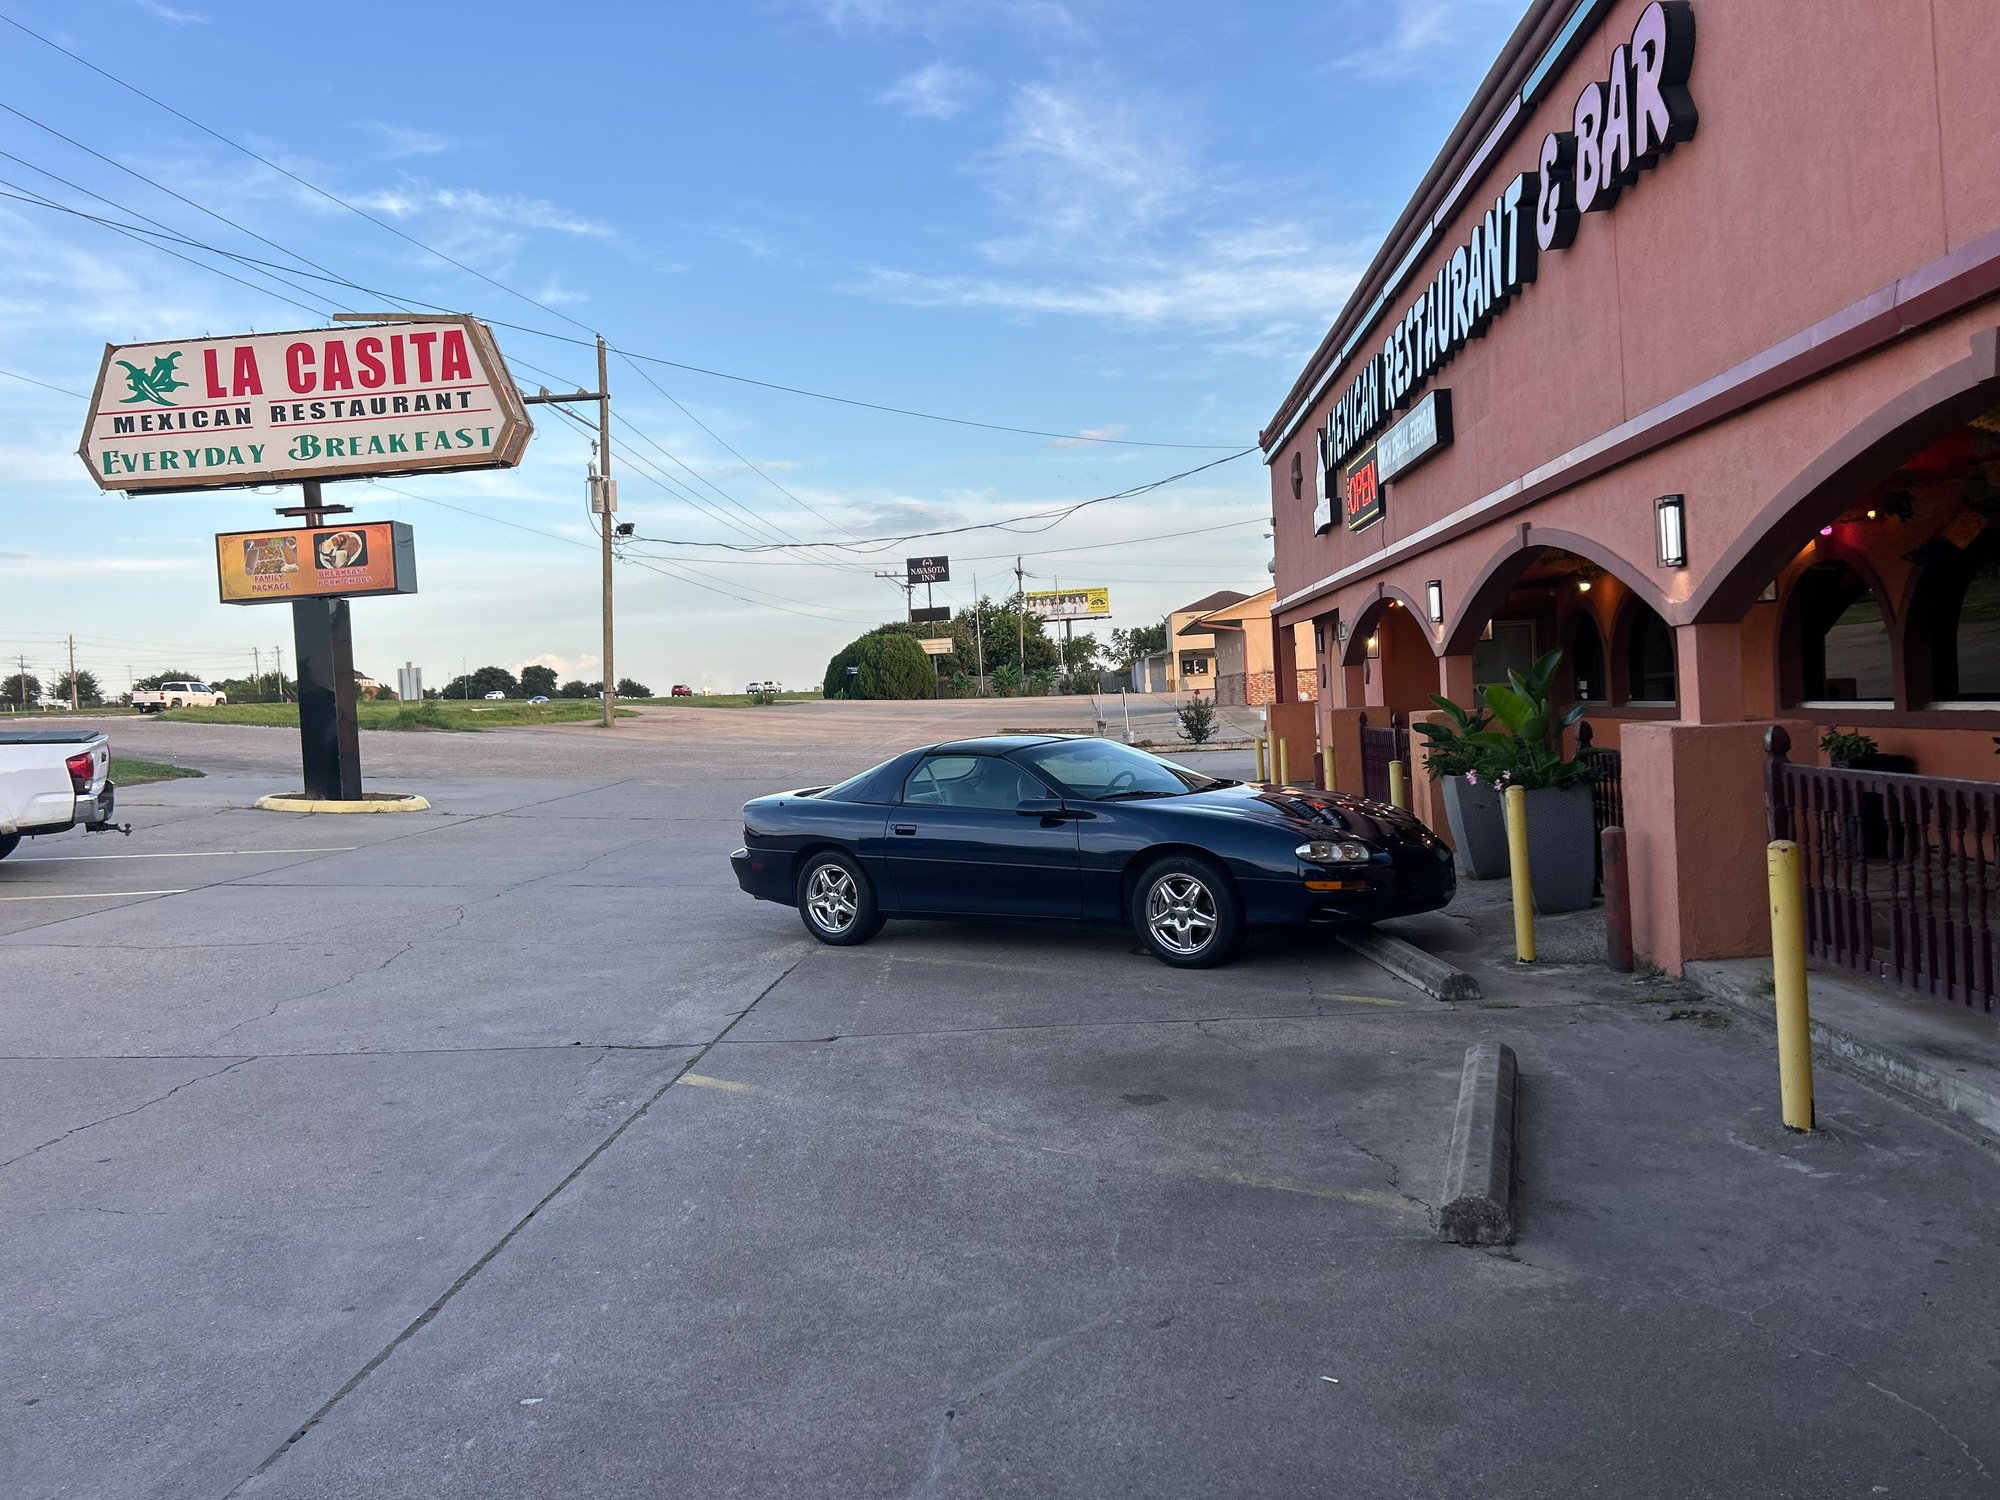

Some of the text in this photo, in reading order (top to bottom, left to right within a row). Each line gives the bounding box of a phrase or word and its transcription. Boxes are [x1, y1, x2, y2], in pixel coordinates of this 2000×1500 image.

[1326, 1, 1669, 472] MEXICAN RESTAURANT & BAR
[203, 329, 473, 399] LA CASITA
[113, 390, 473, 434] MEXICAN RESTAURANT
[102, 426, 495, 476] EVERYDAY BREAKFAST
[1349, 460, 1376, 515] OPEN
[251, 582, 291, 592] PACKAGE
[254, 574, 284, 583] FAMILY
[318, 568, 368, 578] BREAKFAST
[910, 566, 946, 575] NAVASOTA
